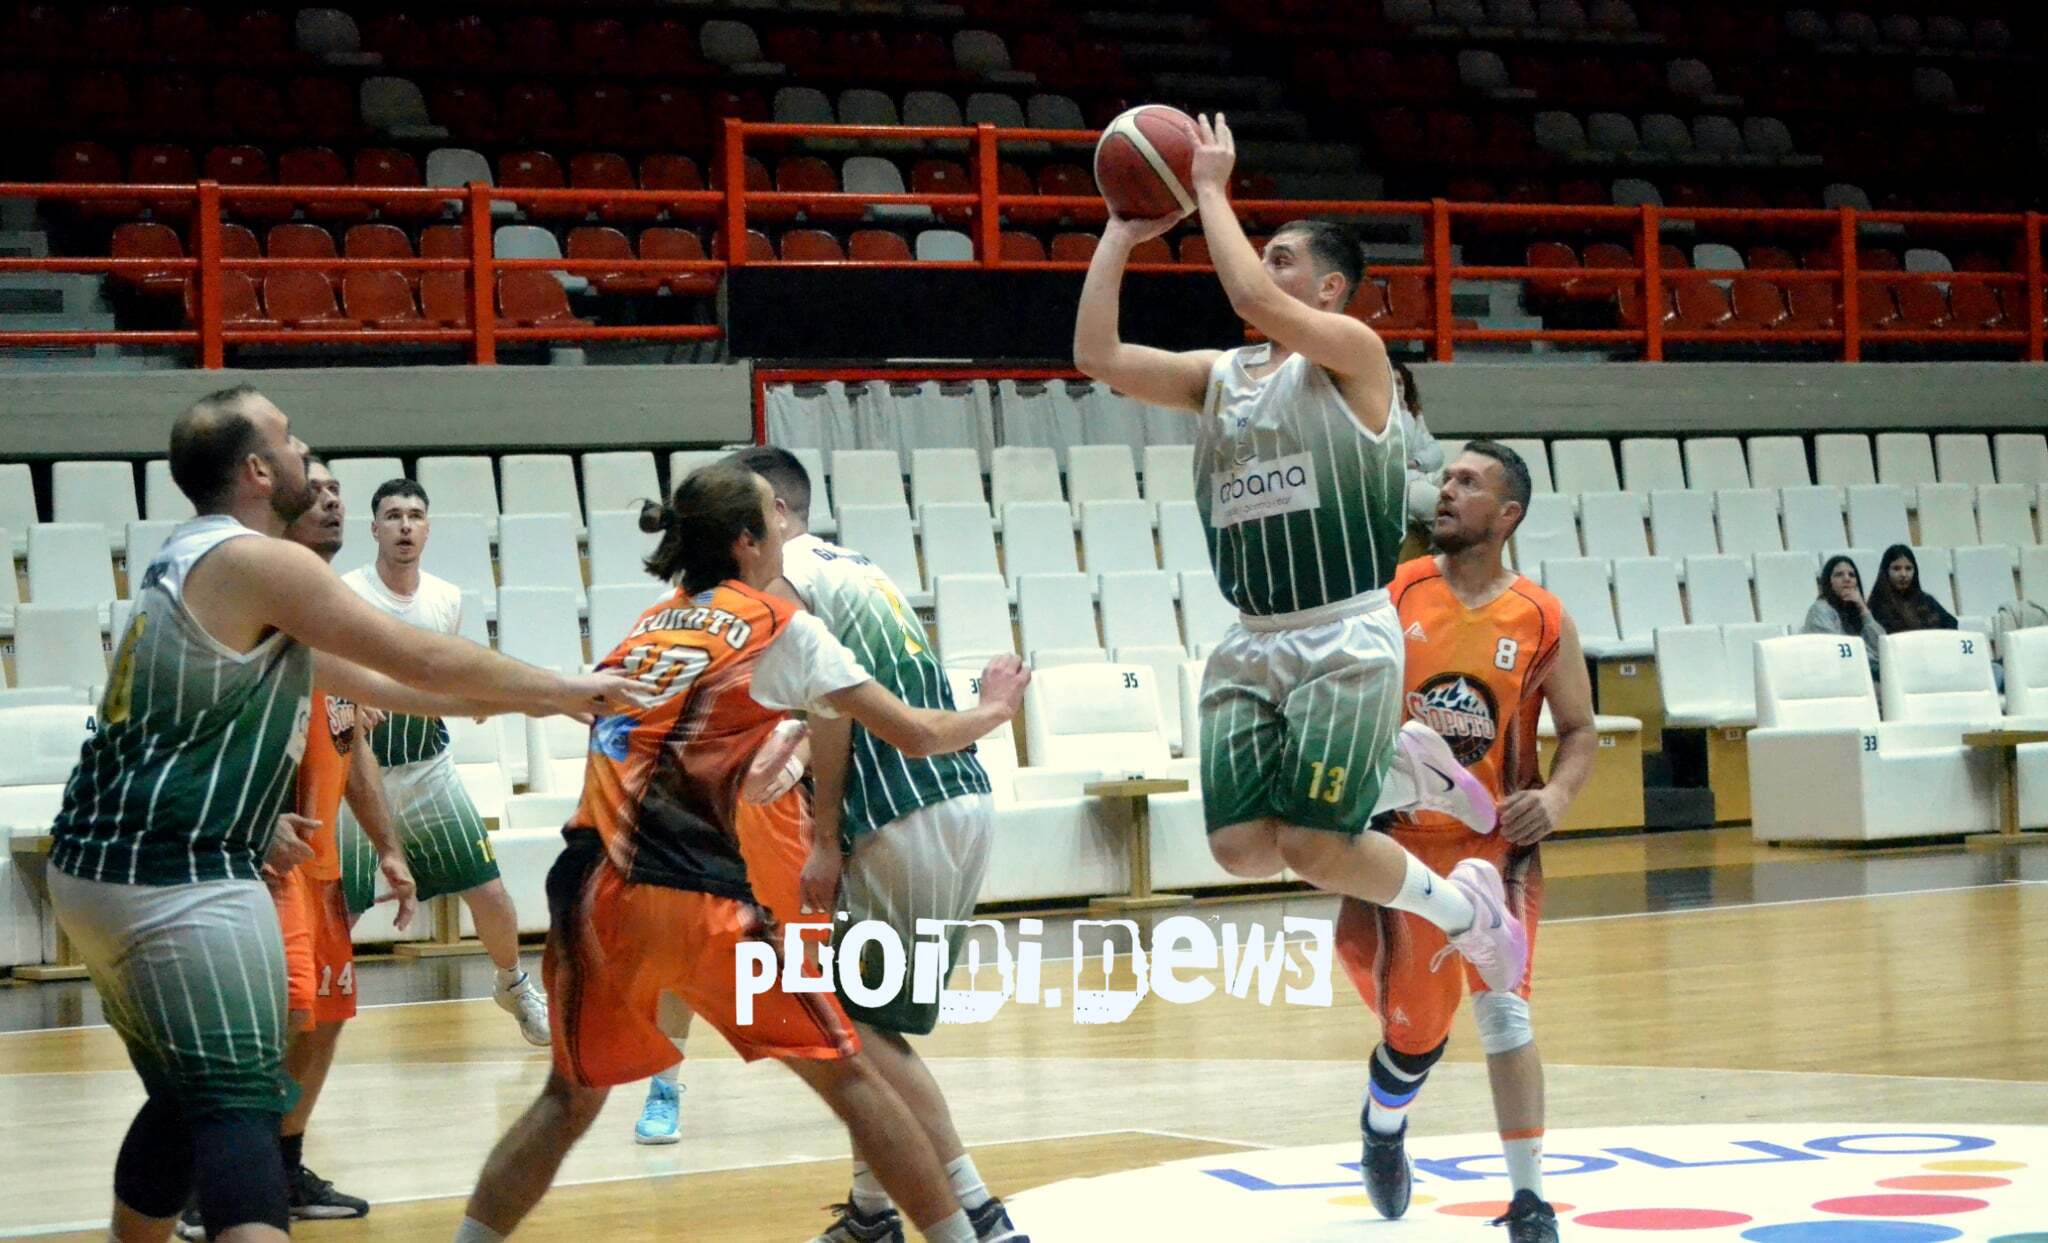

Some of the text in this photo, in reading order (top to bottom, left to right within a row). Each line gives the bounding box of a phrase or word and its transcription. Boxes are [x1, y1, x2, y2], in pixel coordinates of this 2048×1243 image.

[1494, 636, 1518, 672] 8
[1838, 642, 1853, 659] 33
[1960, 639, 1974, 655] 32
[1121, 672, 1139, 689] 35
[85, 715, 97, 734] 4
[1863, 735, 1878, 752] 33
[1308, 760, 1346, 804] 13
[317, 961, 353, 996] 14
